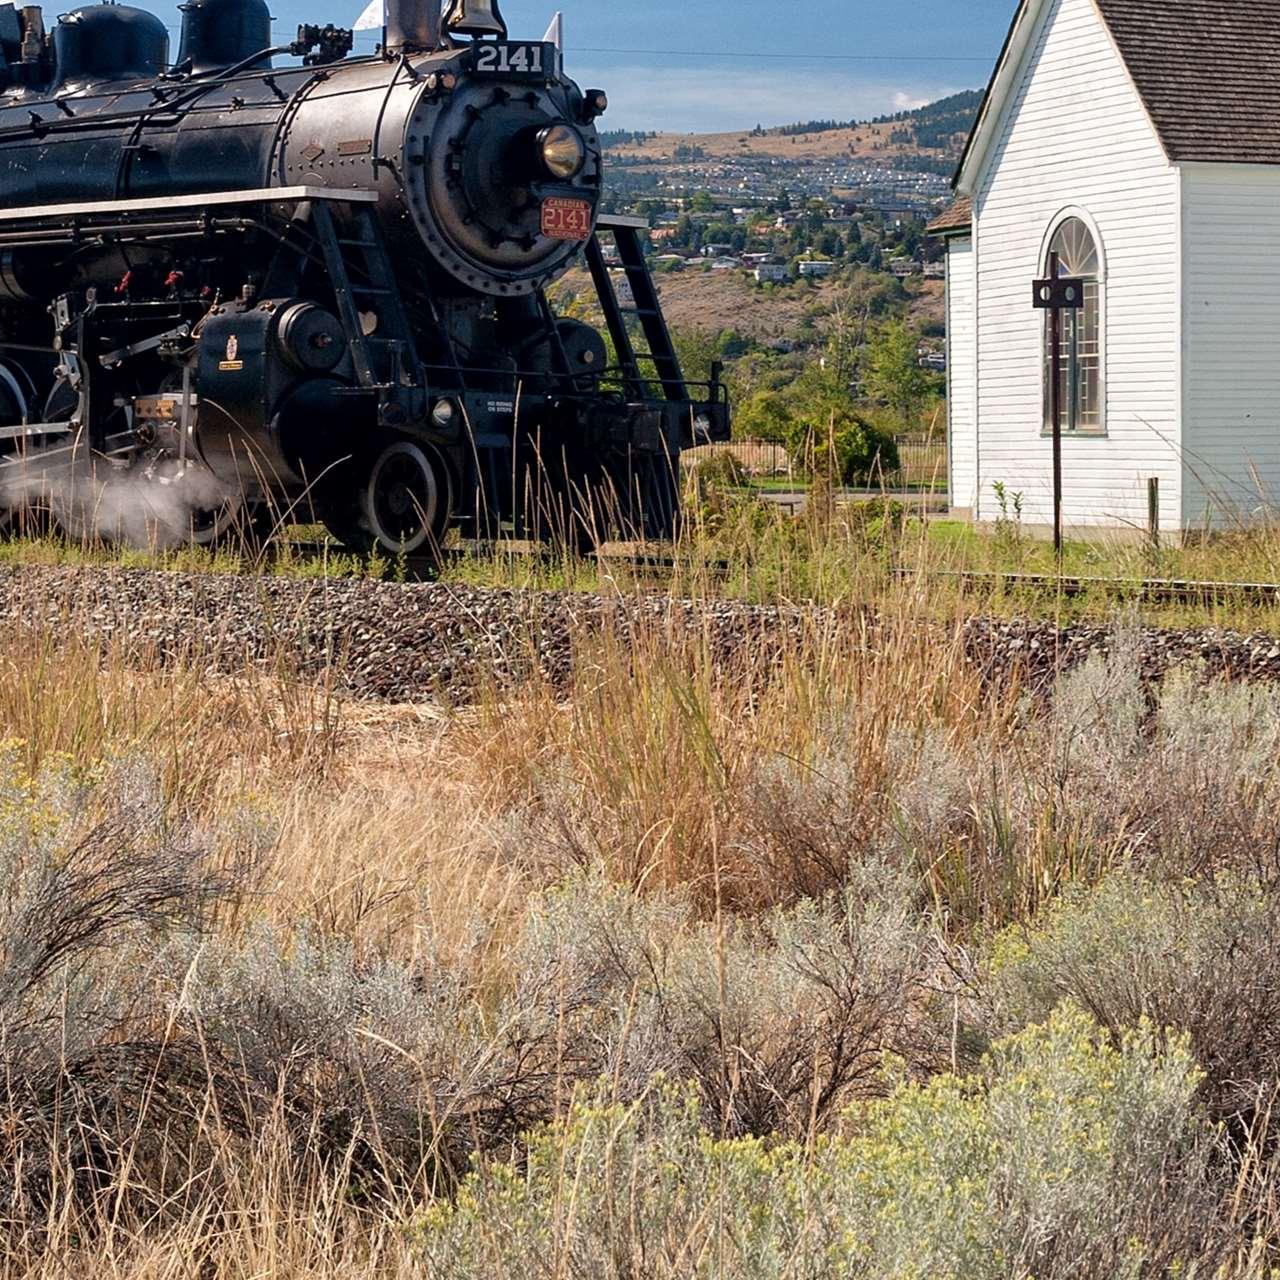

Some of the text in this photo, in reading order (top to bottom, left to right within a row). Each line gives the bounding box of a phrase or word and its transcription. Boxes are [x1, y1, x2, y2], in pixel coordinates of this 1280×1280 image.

[477, 45, 542, 72] 2141
[548, 199, 585, 209] CANADIAN
[545, 209, 588, 230] 2141
